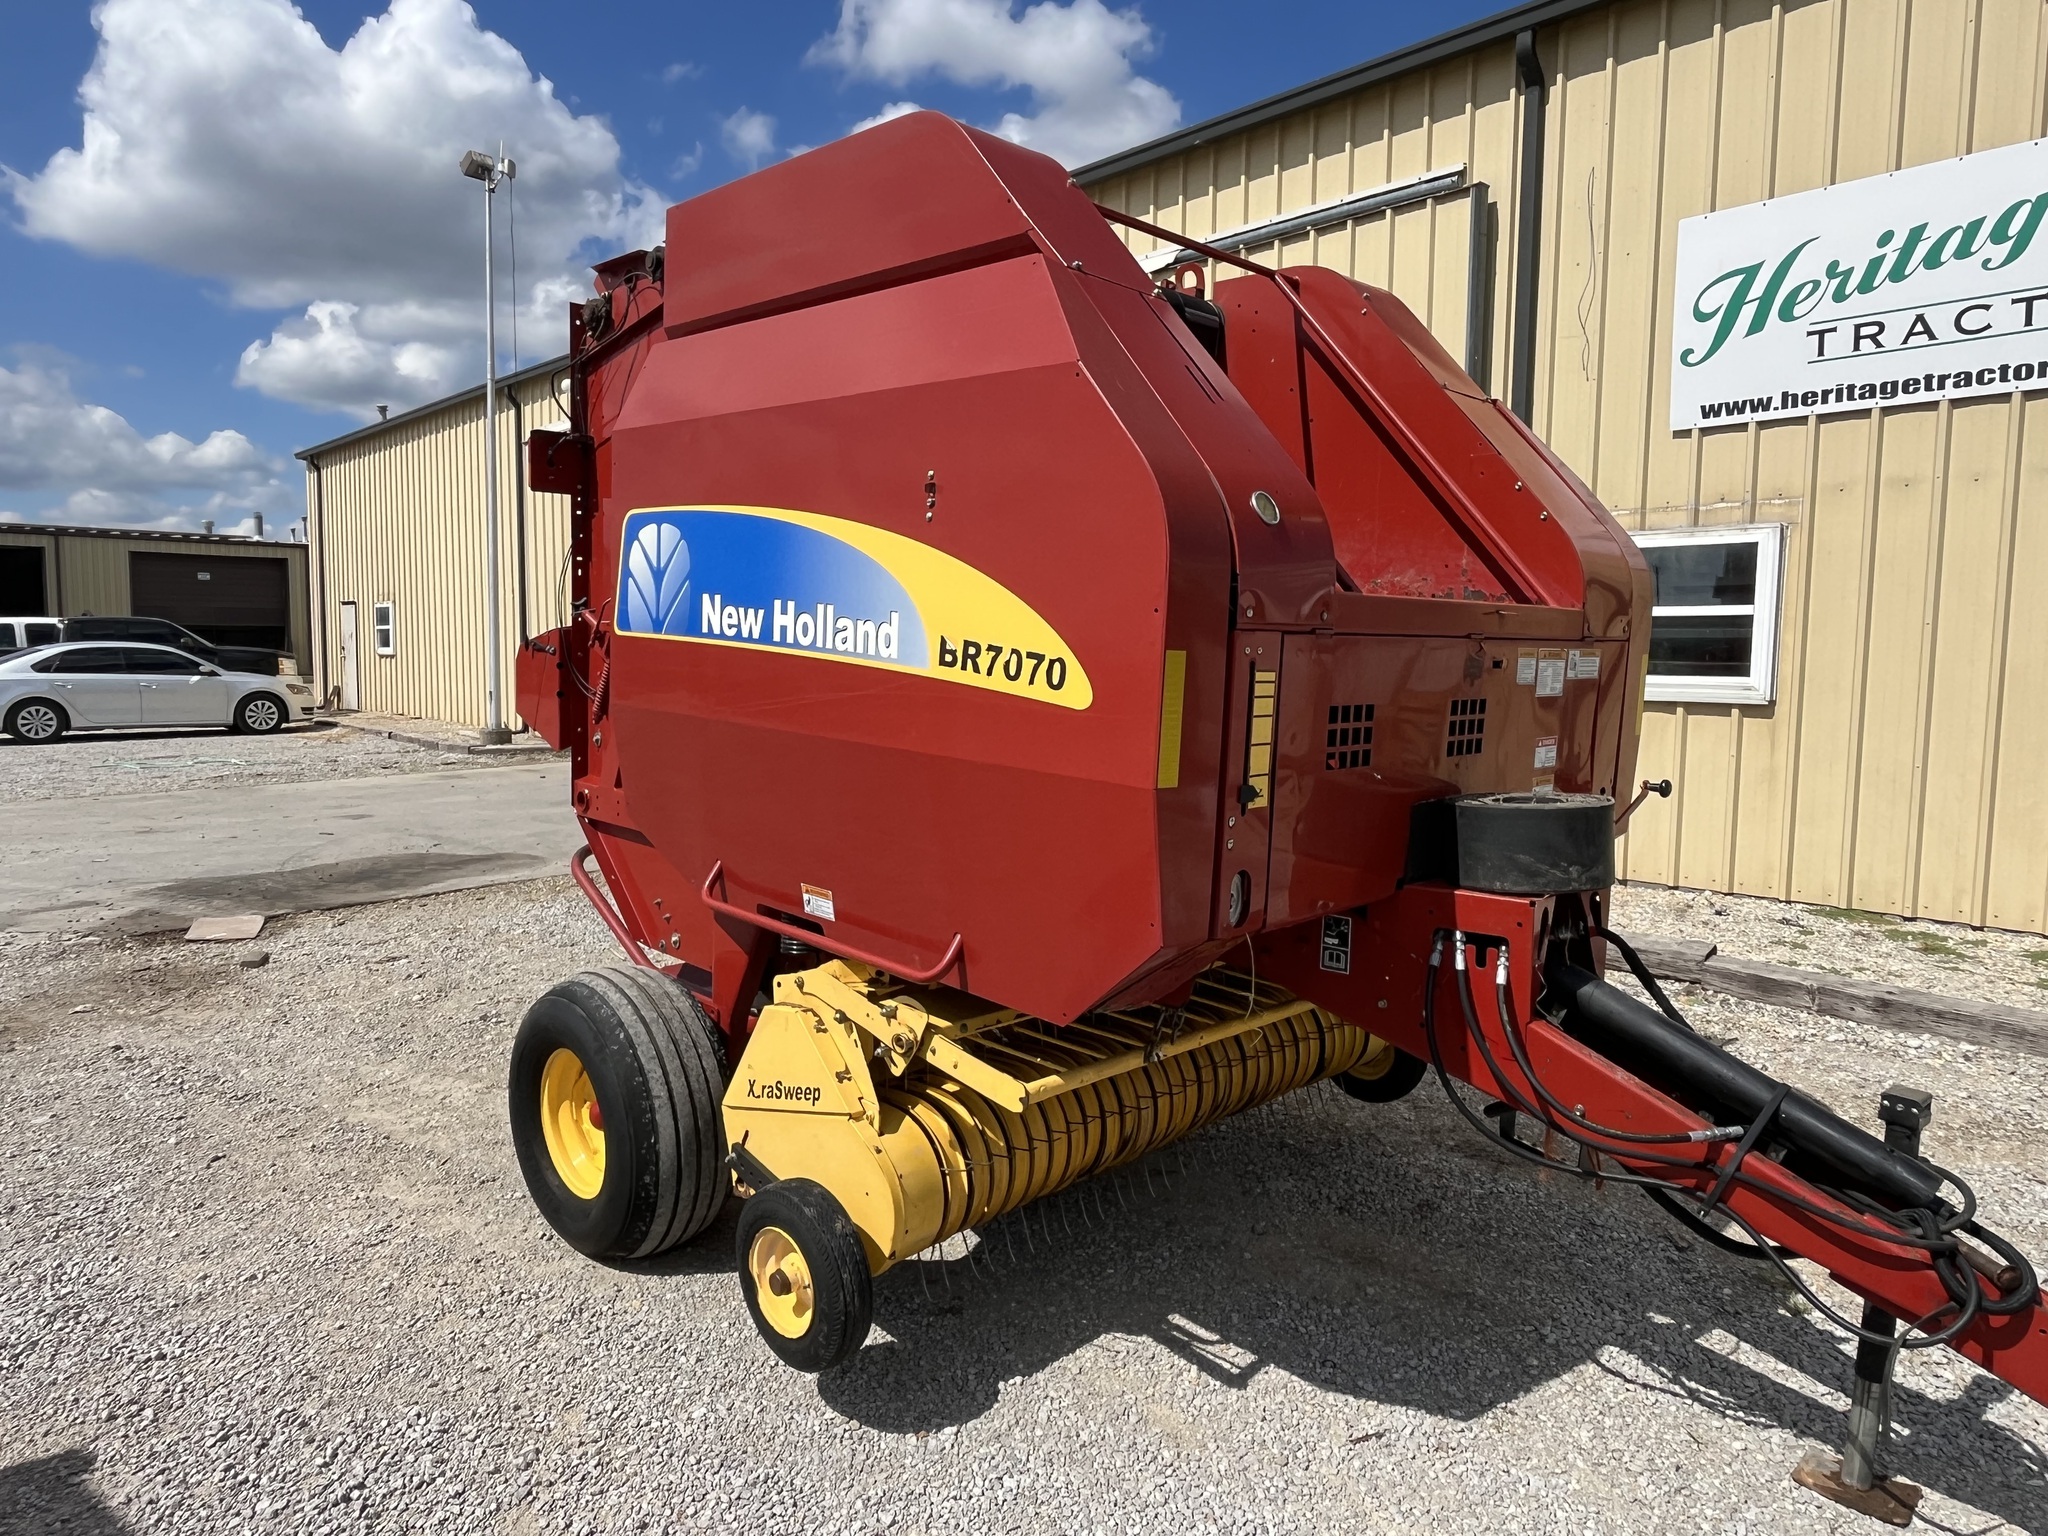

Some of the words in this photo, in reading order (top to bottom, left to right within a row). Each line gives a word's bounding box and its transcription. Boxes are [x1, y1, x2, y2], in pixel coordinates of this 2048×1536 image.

[701, 594, 764, 640] New
[773, 599, 900, 660] Holland
[938, 635, 1067, 691] BR7070
[748, 1078, 821, 1107] XraSweep
